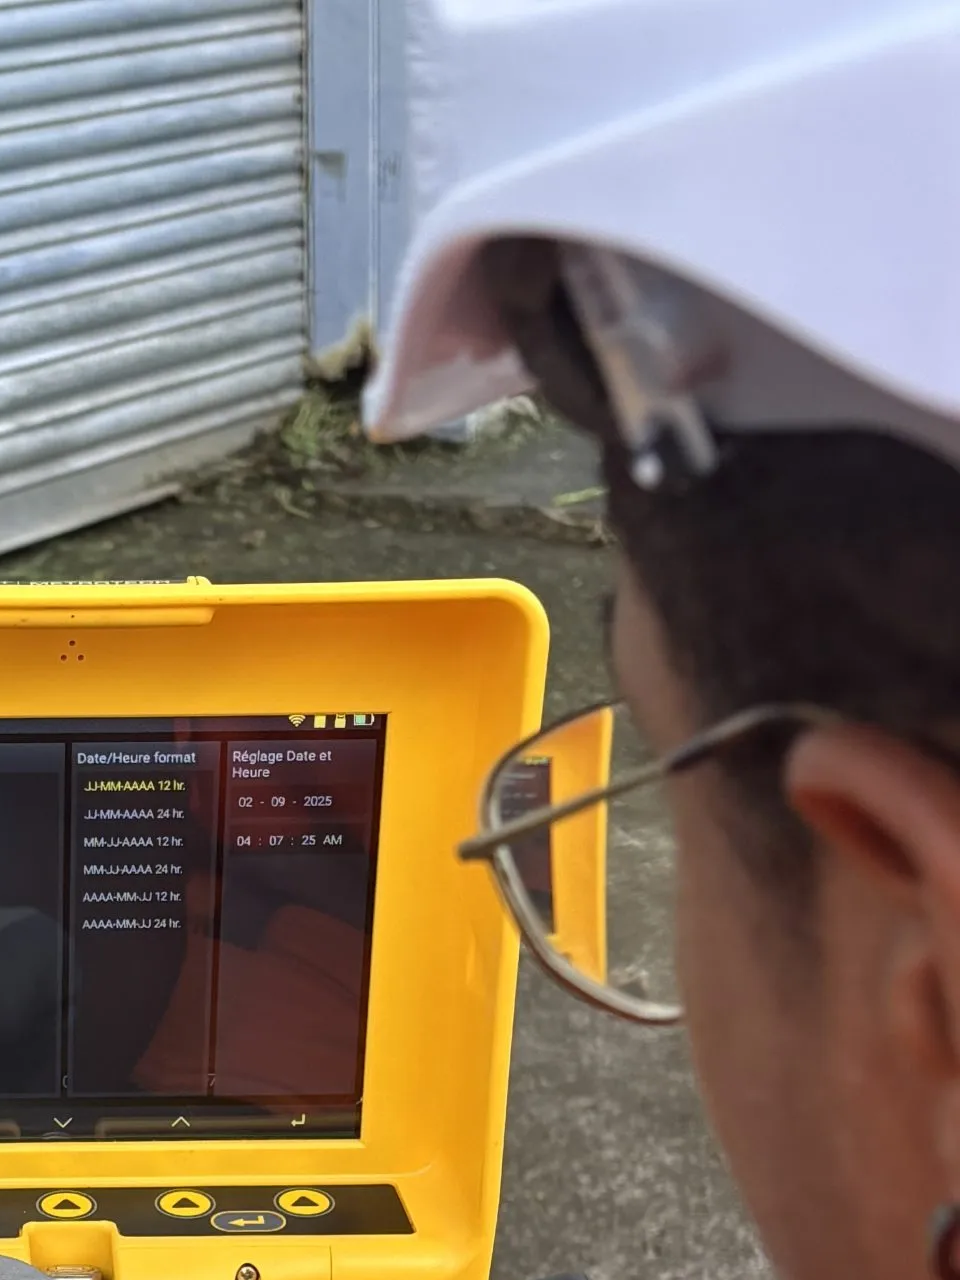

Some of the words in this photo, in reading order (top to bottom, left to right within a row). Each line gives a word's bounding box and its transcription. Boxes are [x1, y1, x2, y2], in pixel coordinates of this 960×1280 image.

[78, 752, 150, 764] Date/Heure
[154, 752, 195, 763] format
[233, 751, 283, 764] Réglage
[287, 751, 316, 761] Date
[320, 751, 331, 760] et
[233, 767, 270, 777] Heure
[85, 781, 155, 791] JJ-MM-AAAA
[158, 780, 170, 790] 12
[174, 780, 185, 790] hr.
[239, 797, 252, 807] 02
[272, 797, 285, 806] 09
[304, 796, 332, 806] 2025
[84, 809, 154, 819] JJ-MM-AAAA
[157, 809, 169, 818] 24
[173, 808, 184, 818] hr.
[84, 837, 153, 847] MM-JJ-AAAA
[157, 837, 169, 846] 12
[172, 837, 183, 846] hr.
[237, 836, 250, 846] 04
[270, 836, 283, 845] 07
[302, 835, 315, 845] 25
[323, 835, 342, 845] AM
[84, 865, 152, 874] MM-JJ-AAAA
[156, 864, 168, 874] 24
[171, 864, 182, 873] hr.
[83, 892, 152, 902] AAAA-MM-JJ
[155, 892, 167, 901] 12
[170, 891, 181, 900] hr.
[83, 919, 151, 929] AAAA-MM-JJ
[154, 919, 166, 928] 24
[169, 918, 181, 928] hr.
